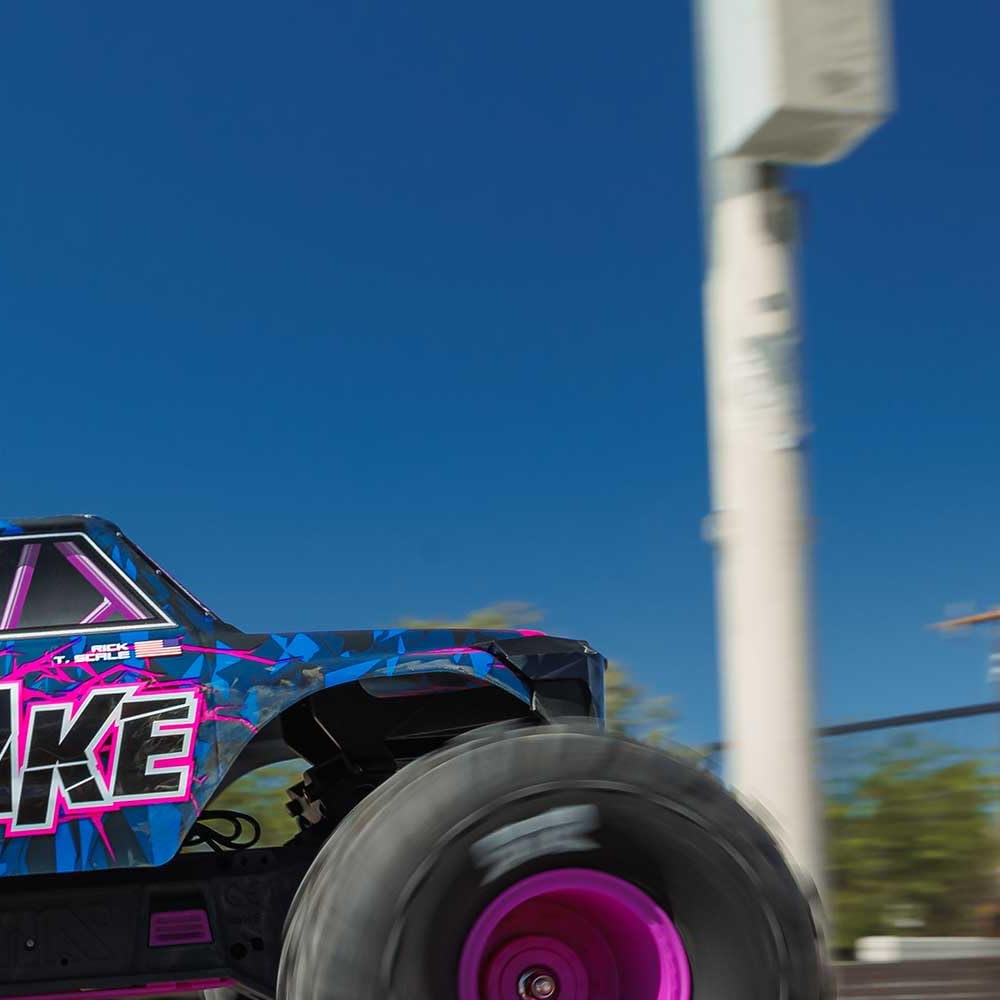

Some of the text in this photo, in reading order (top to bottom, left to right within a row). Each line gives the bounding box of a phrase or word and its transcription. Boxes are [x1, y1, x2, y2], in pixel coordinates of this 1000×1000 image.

[91, 643, 129, 652] RICK
[53, 650, 130, 664] T. SCALE
